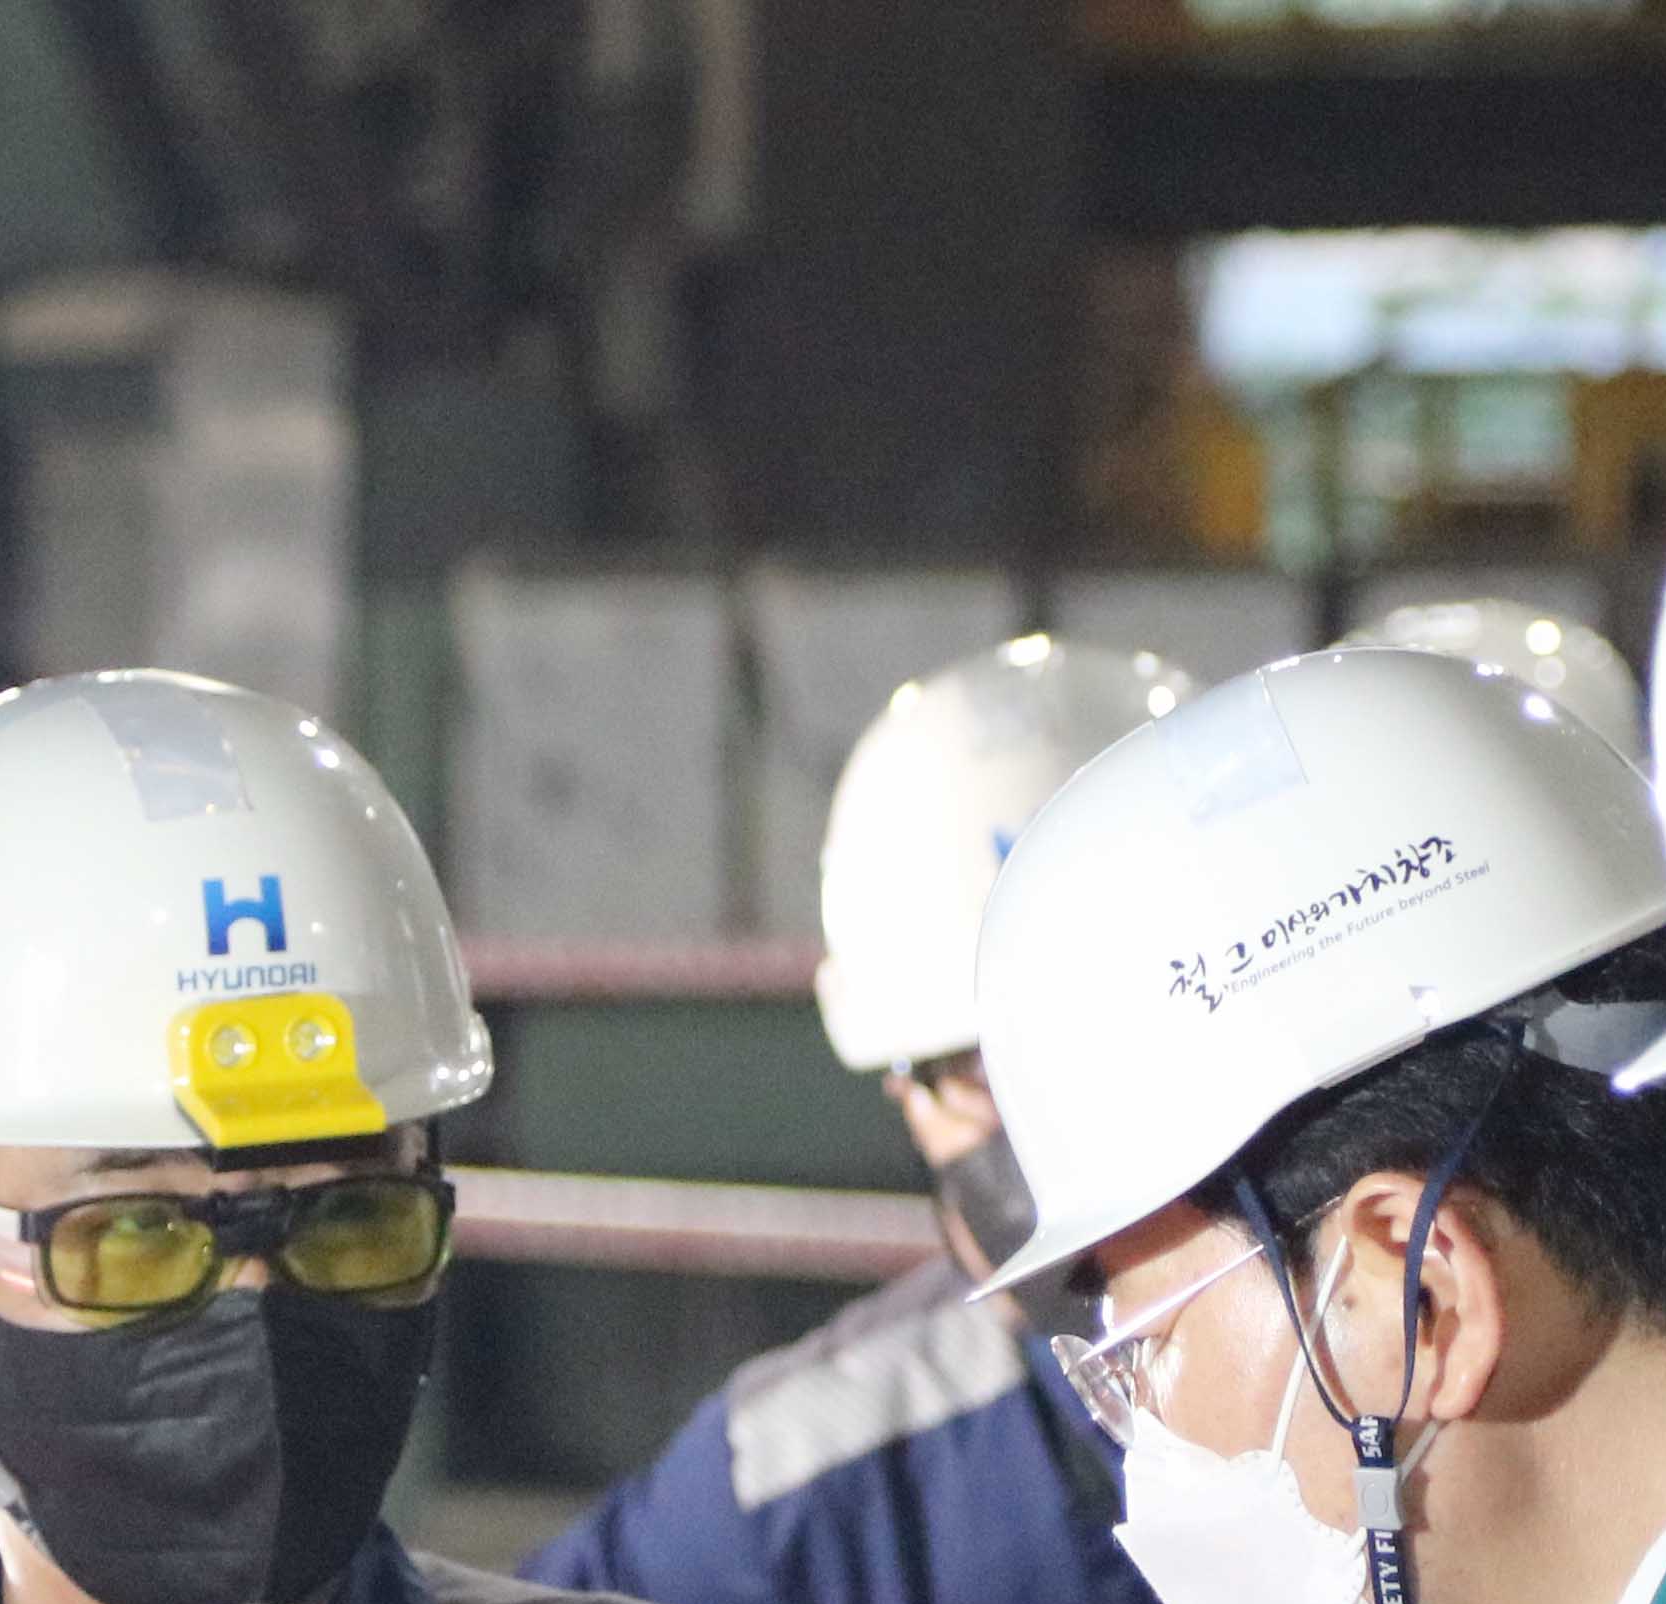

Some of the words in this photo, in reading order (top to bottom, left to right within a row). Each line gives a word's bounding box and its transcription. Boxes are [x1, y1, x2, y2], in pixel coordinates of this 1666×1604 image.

[1232, 943, 1316, 994] Engineering
[1318, 930, 1344, 948] the
[1346, 904, 1395, 937] Future
[1398, 878, 1452, 912] beyond
[1454, 860, 1491, 886] Steel
[1225, 941, 1254, 975] 그
[175, 962, 319, 993] HYUNDAI
